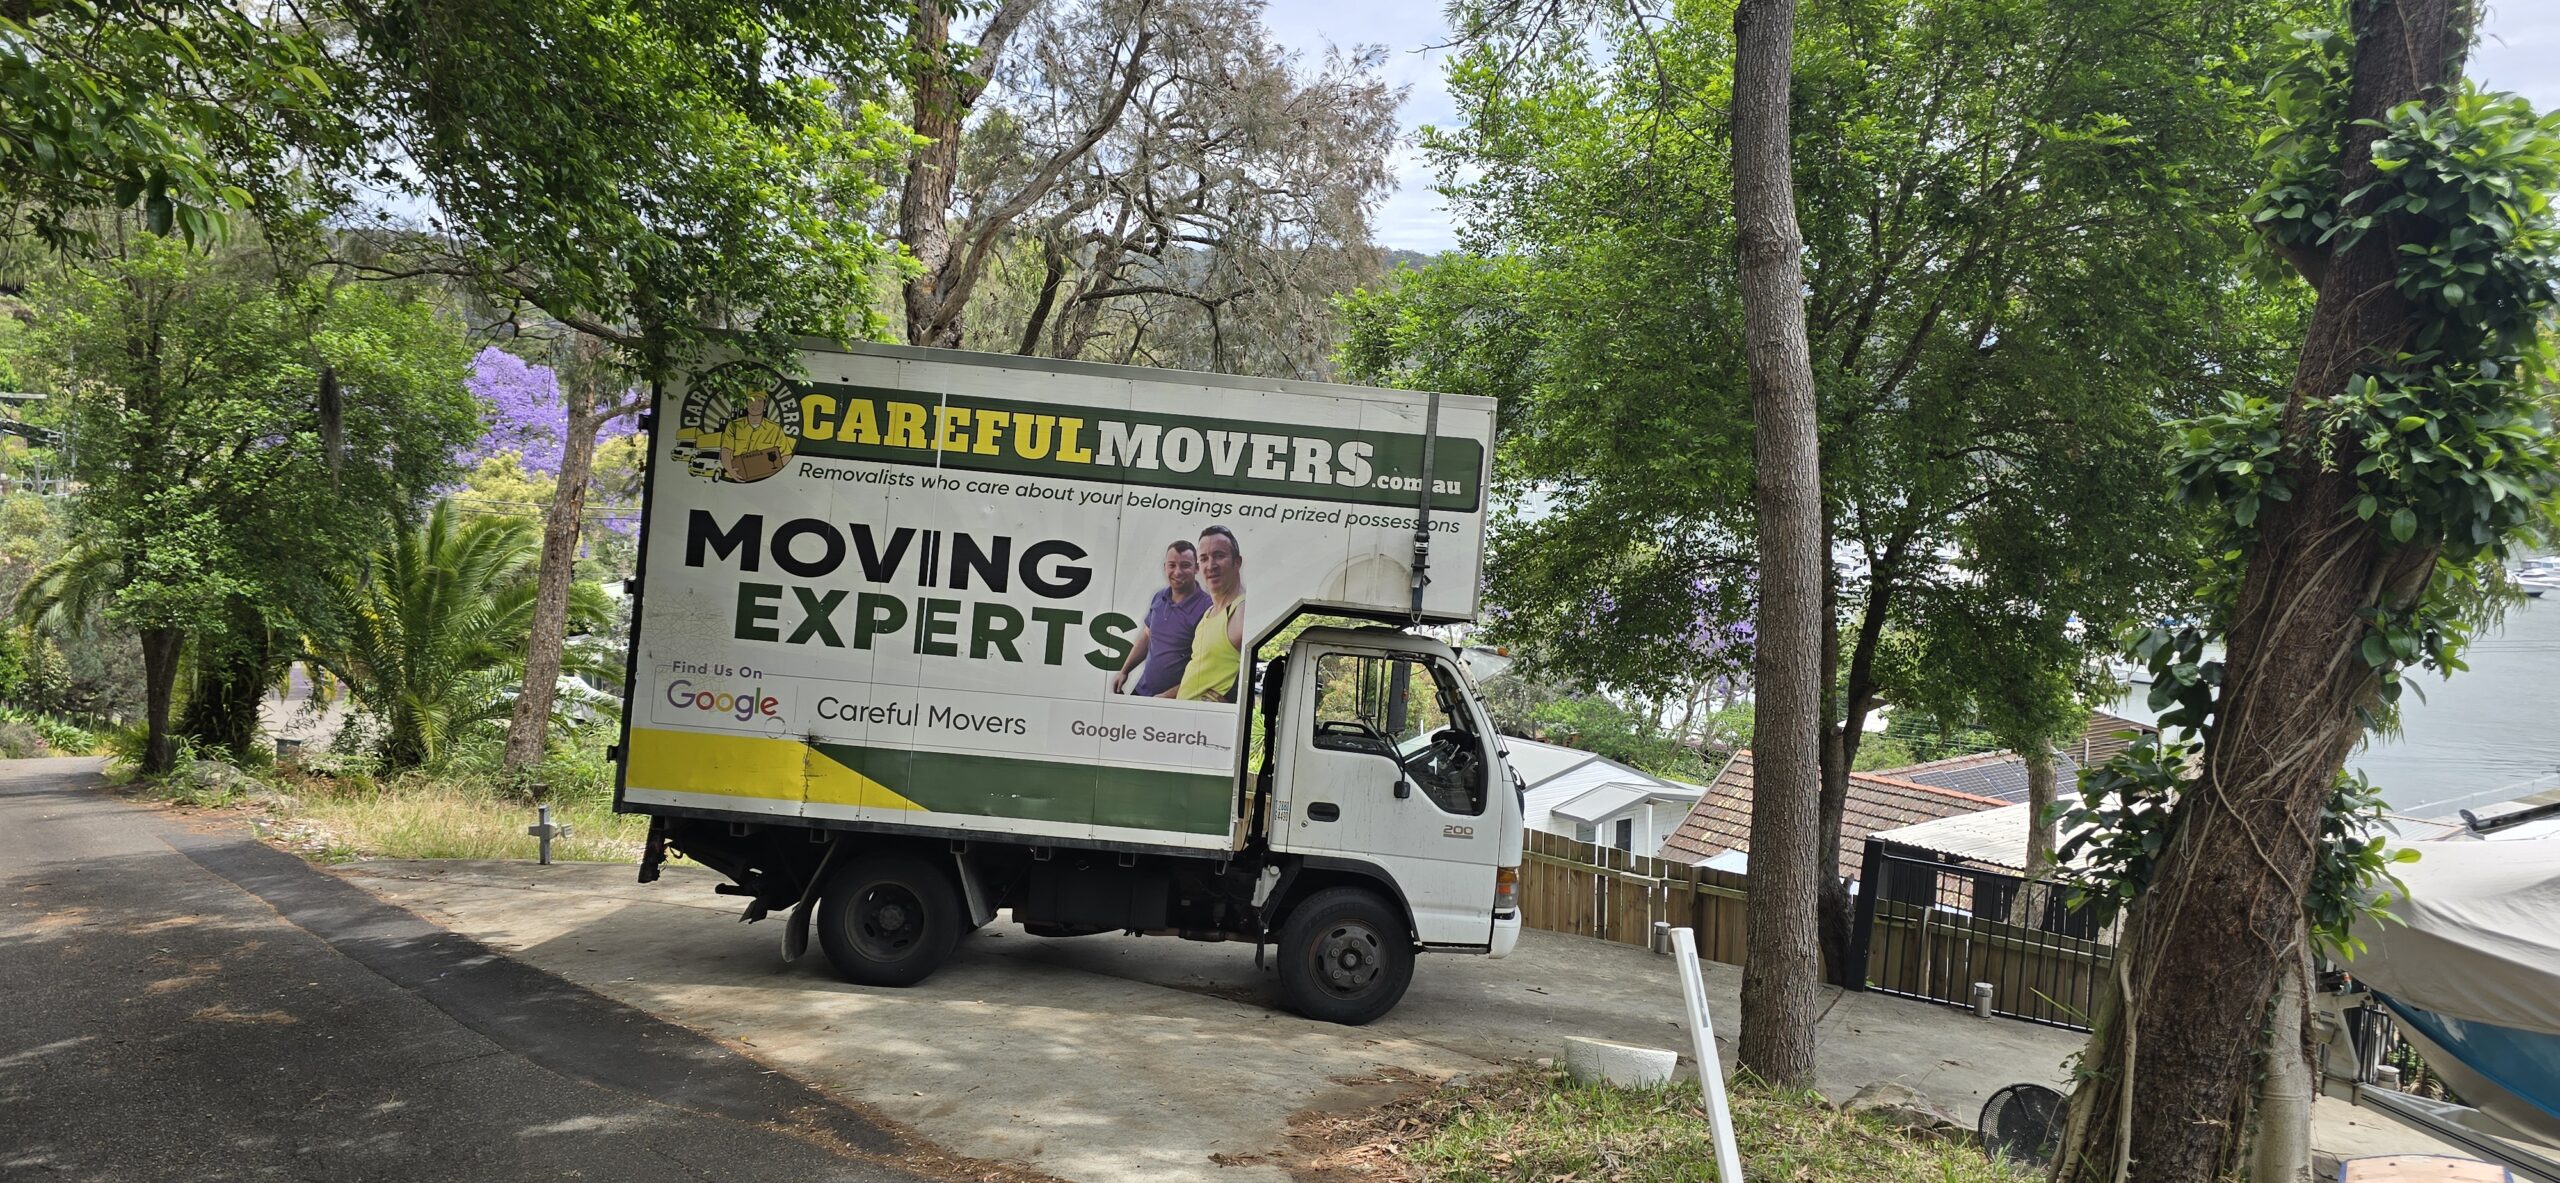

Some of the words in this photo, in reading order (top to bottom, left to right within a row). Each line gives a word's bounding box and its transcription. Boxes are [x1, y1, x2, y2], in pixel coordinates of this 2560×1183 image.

[799, 462, 915, 487] Removalists
[921, 474, 961, 492] who
[968, 480, 1010, 496] care
[1015, 481, 1074, 502] about
[1079, 487, 1123, 508] your
[1127, 492, 1232, 517] belongings
[1239, 504, 1277, 520] and
[1280, 505, 1341, 527] prized
[1345, 513, 1461, 533] possessons
[685, 509, 1092, 599] MOVING
[734, 582, 1138, 672] EXPERTS
[672, 660, 708, 675] Find
[714, 664, 733, 677] Us
[740, 666, 763, 680] On
[667, 679, 779, 722] Google
[817, 696, 919, 726] Careful
[928, 706, 1026, 736] Movers
[1071, 720, 1137, 742] Google
[1142, 726, 1207, 747] Search
[1443, 824, 1474, 835] 200
